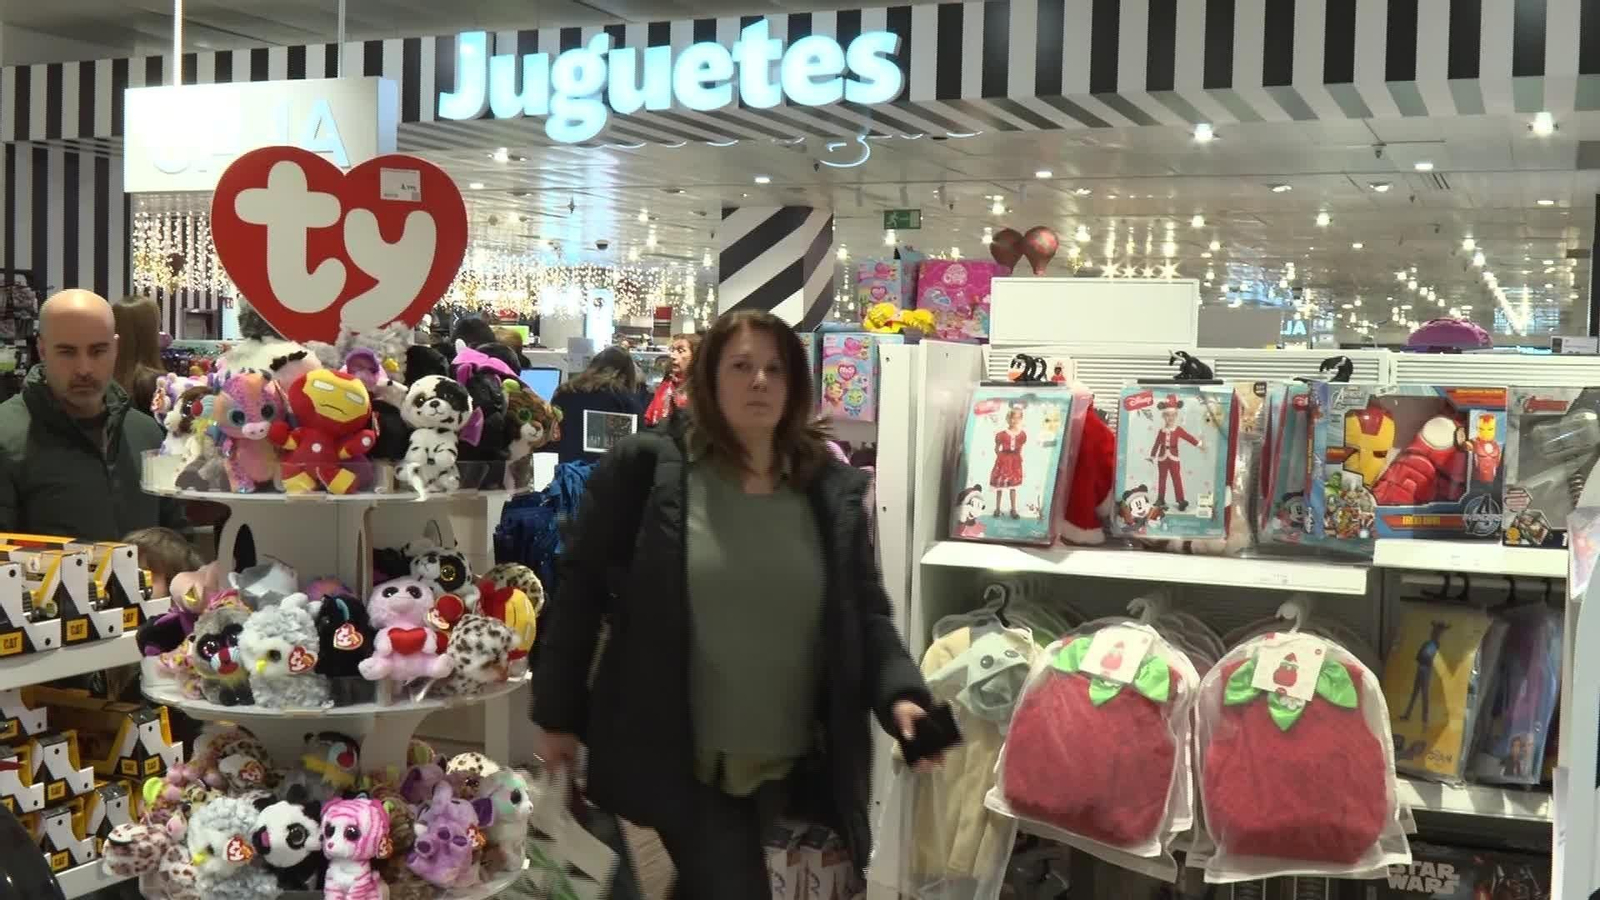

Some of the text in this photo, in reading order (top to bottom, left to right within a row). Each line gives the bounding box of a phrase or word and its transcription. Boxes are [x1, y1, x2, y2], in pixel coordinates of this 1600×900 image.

[438, 19, 903, 143] Juguetes
[234, 160, 437, 333] ty
[70, 624, 84, 636] CAT
[3, 637, 18, 650] CAT
[1387, 873, 1460, 894] WARS
